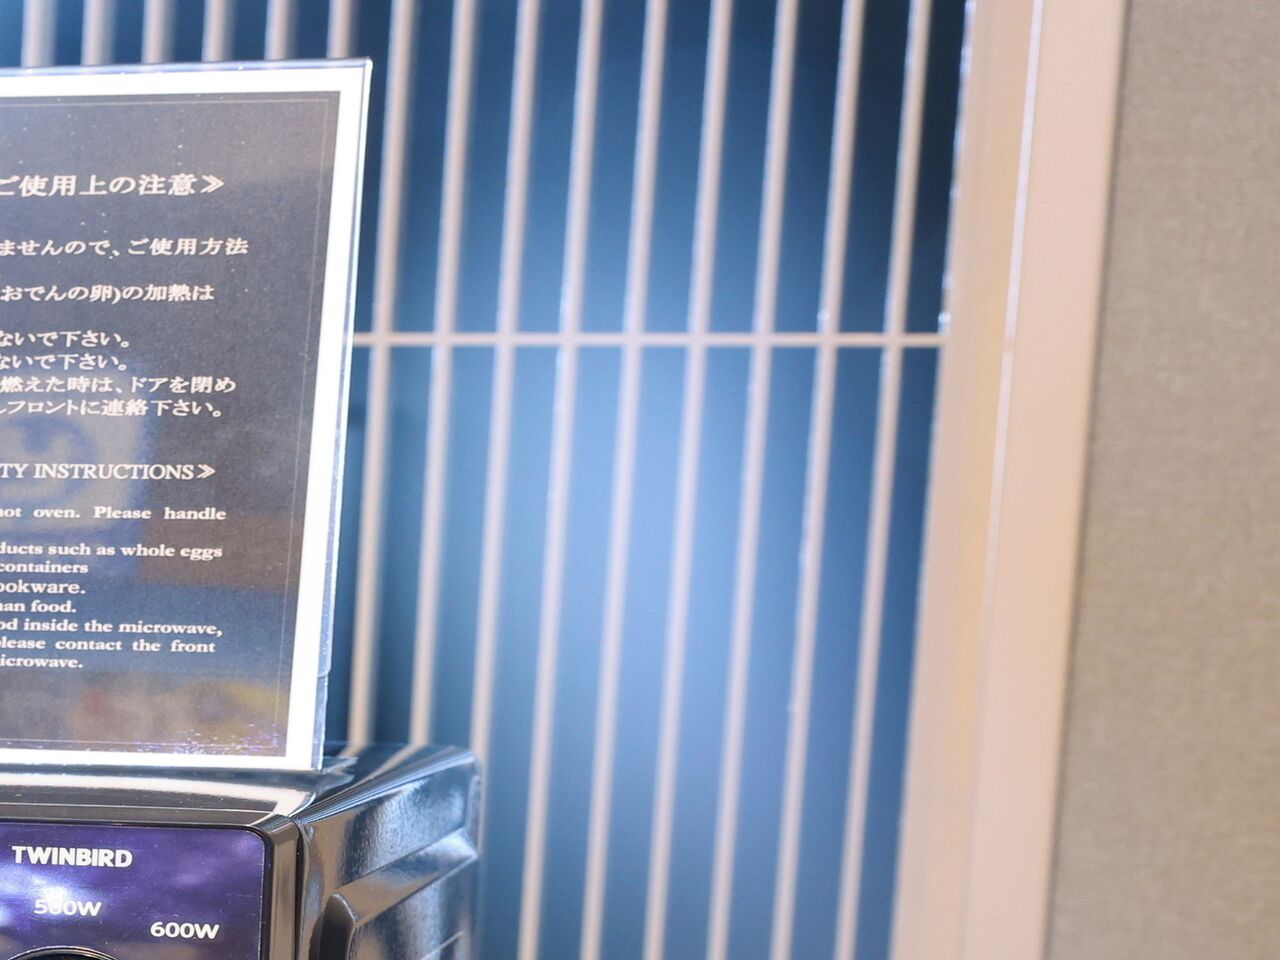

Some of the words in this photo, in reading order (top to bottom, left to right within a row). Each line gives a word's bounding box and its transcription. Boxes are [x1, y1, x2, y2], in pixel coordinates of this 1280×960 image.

[34, 509, 80, 518] oven.
[93, 506, 151, 518] Please
[164, 507, 226, 520] handle
[48, 543, 91, 555] such
[96, 547, 115, 555] as
[120, 544, 175, 556] whole
[180, 548, 222, 560] eggs
[31, 600, 76, 612] food.
[24, 618, 78, 631] inside
[85, 620, 112, 632] the
[119, 621, 222, 637] microwave,
[55, 641, 121, 650] contact
[133, 639, 160, 651] the
[171, 640, 215, 652] front
[12, 846, 132, 867] TWINBIRD
[33, 899, 102, 916] 500W
[151, 922, 219, 939] 600W
